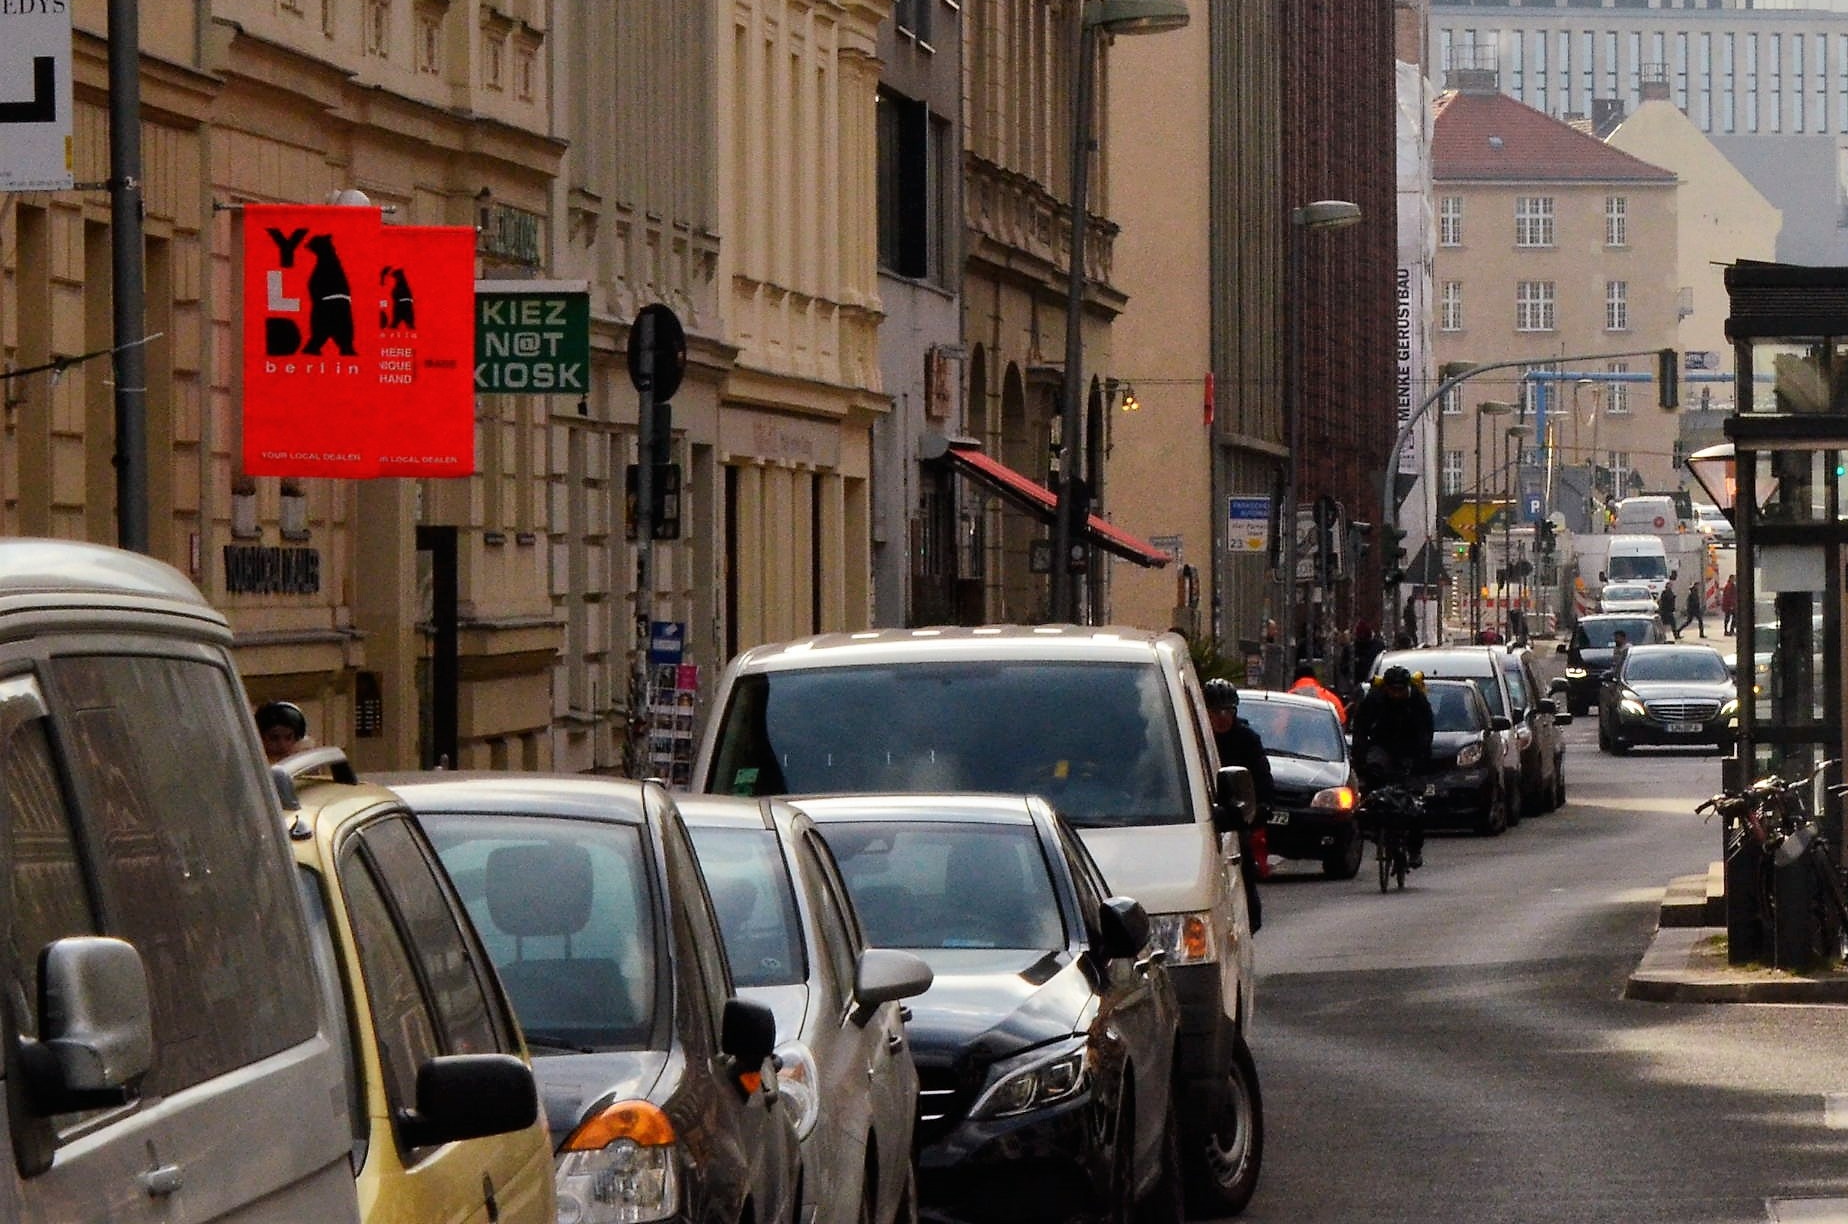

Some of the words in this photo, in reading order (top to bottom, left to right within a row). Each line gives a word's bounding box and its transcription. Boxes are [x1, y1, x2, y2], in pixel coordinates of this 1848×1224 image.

[482, 300, 567, 325] KIEZ
[485, 332, 564, 358] N@T
[265, 360, 360, 375] berlin
[474, 362, 582, 388] KIOSK
[379, 374, 413, 385] HAND
[1398, 366, 1410, 421] MENKE
[262, 451, 288, 460] YOUR
[289, 452, 321, 460] LOCAL
[323, 453, 361, 462] DEALER
[390, 456, 420, 464] LOCAL
[422, 456, 458, 465] DEALER
[1530, 499, 1541, 513] P
